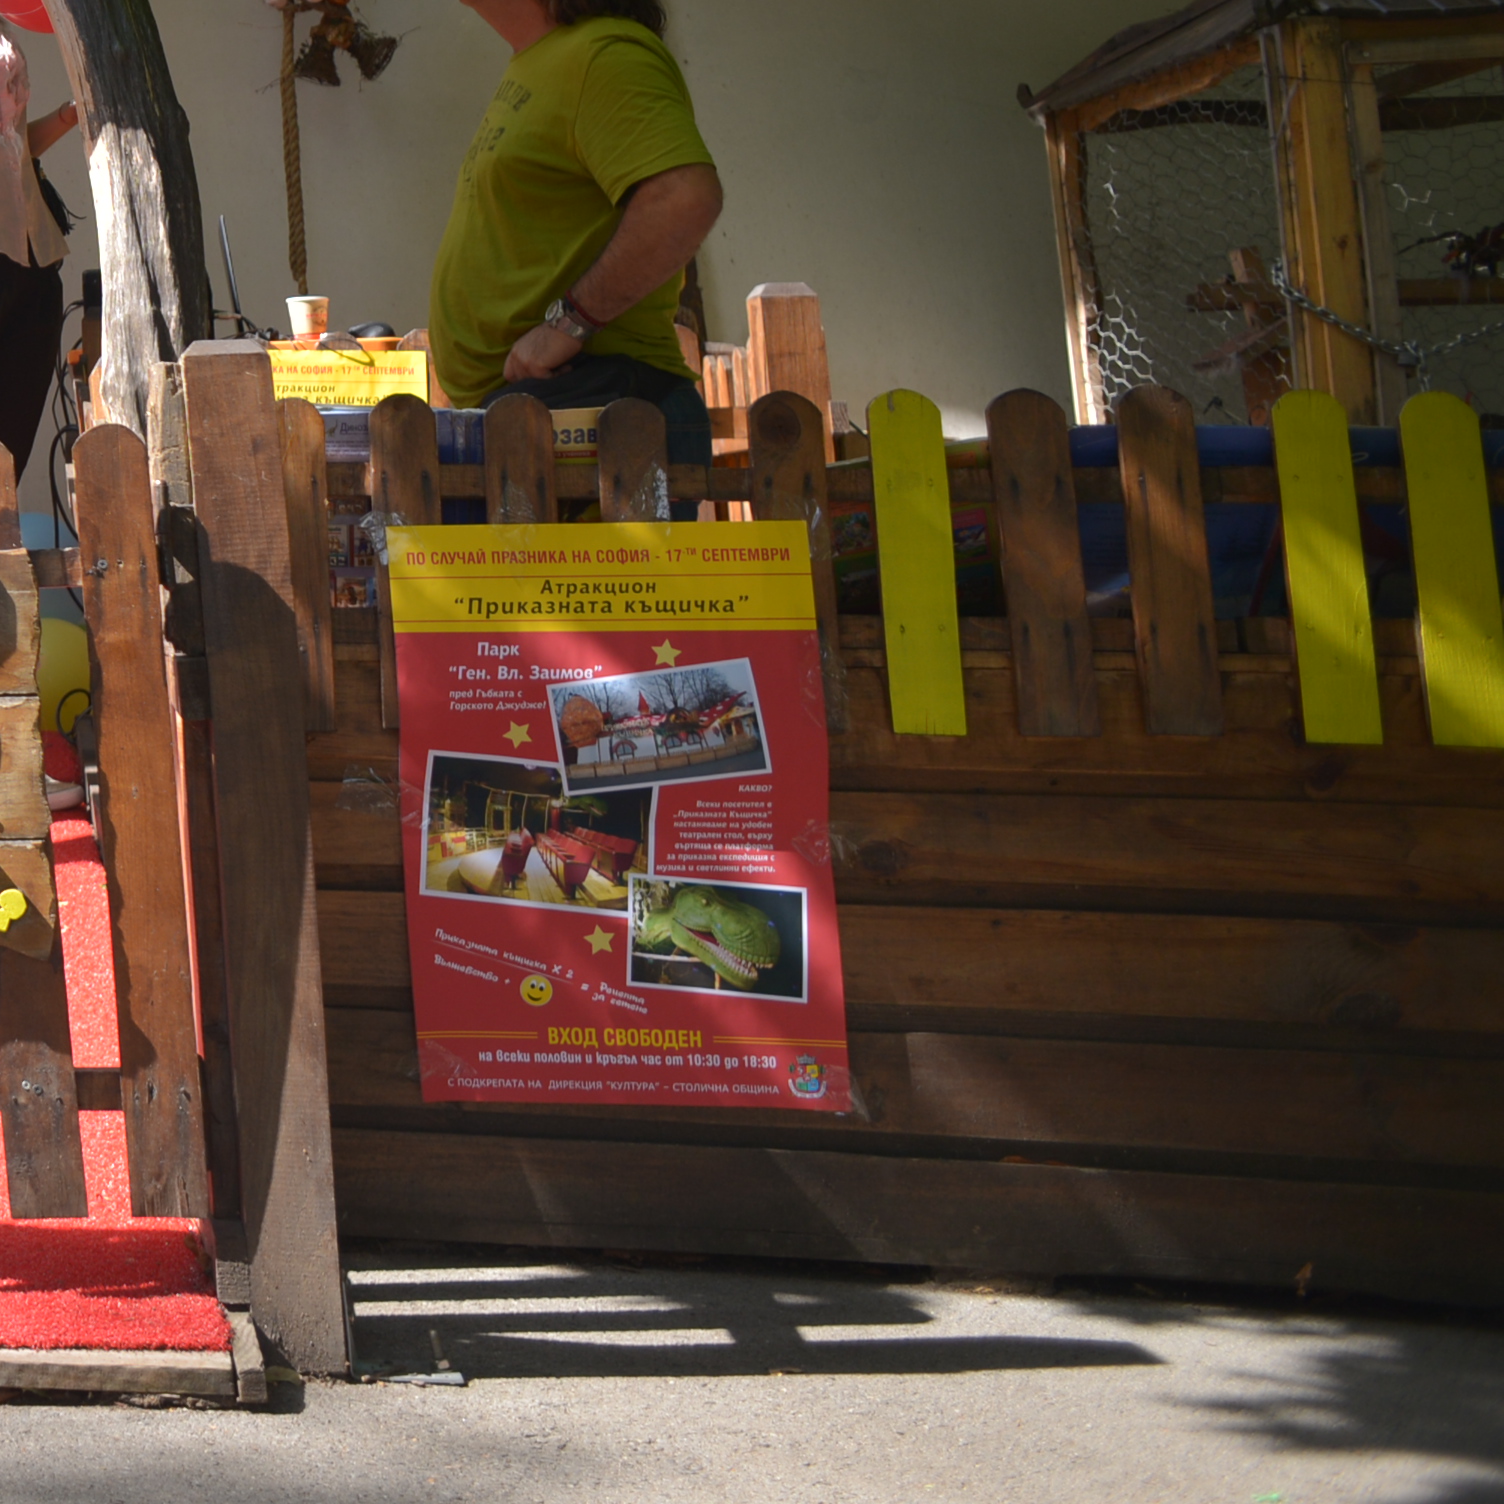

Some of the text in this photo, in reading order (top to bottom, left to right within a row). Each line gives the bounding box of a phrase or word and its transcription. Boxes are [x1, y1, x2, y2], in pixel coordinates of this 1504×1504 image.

[301, 366, 332, 374] СОФИЯ
[363, 366, 414, 375] СЕПТЕМВРИ
[407, 552, 425, 565] ПО
[431, 549, 486, 565] СЛУЧАЙ
[492, 550, 567, 564] ПРАЗНИКА
[572, 550, 591, 564] НА
[596, 547, 650, 565] СОФИЯ
[702, 548, 790, 562] СЕПТЕМВРИ
[540, 579, 656, 598] Атракцион
[454, 595, 749, 619] “Приказната къщичка”
[477, 642, 520, 659] Парк
[498, 666, 523, 680] Вл.
[449, 689, 523, 699] пред Гъбката с
[450, 700, 546, 712] Горското Джудже!
[696, 800, 720, 808] Всеки
[742, 821, 772, 830] удобен
[680, 832, 721, 840] театрален
[725, 842, 773, 852] платформа
[678, 854, 717, 862] приказна
[719, 853, 768, 861] експедиция
[742, 864, 776, 873] ефекти.
[566, 970, 574, 979] 2
[548, 1027, 702, 1050] ВХОД СВОБОДЕН
[479, 1049, 777, 1070] на всеки половин и кръгъл час от 10:30 до 18:30
[447, 1078, 455, 1087] С
[458, 1078, 525, 1088] ПОДКРЕПАТА
[528, 1079, 542, 1089] НА
[549, 1080, 603, 1091] ДИРЕКЦИЯ
[672, 1083, 729, 1093] СТОЛИЧНА
[732, 1084, 780, 1095] ОБЩИНА
